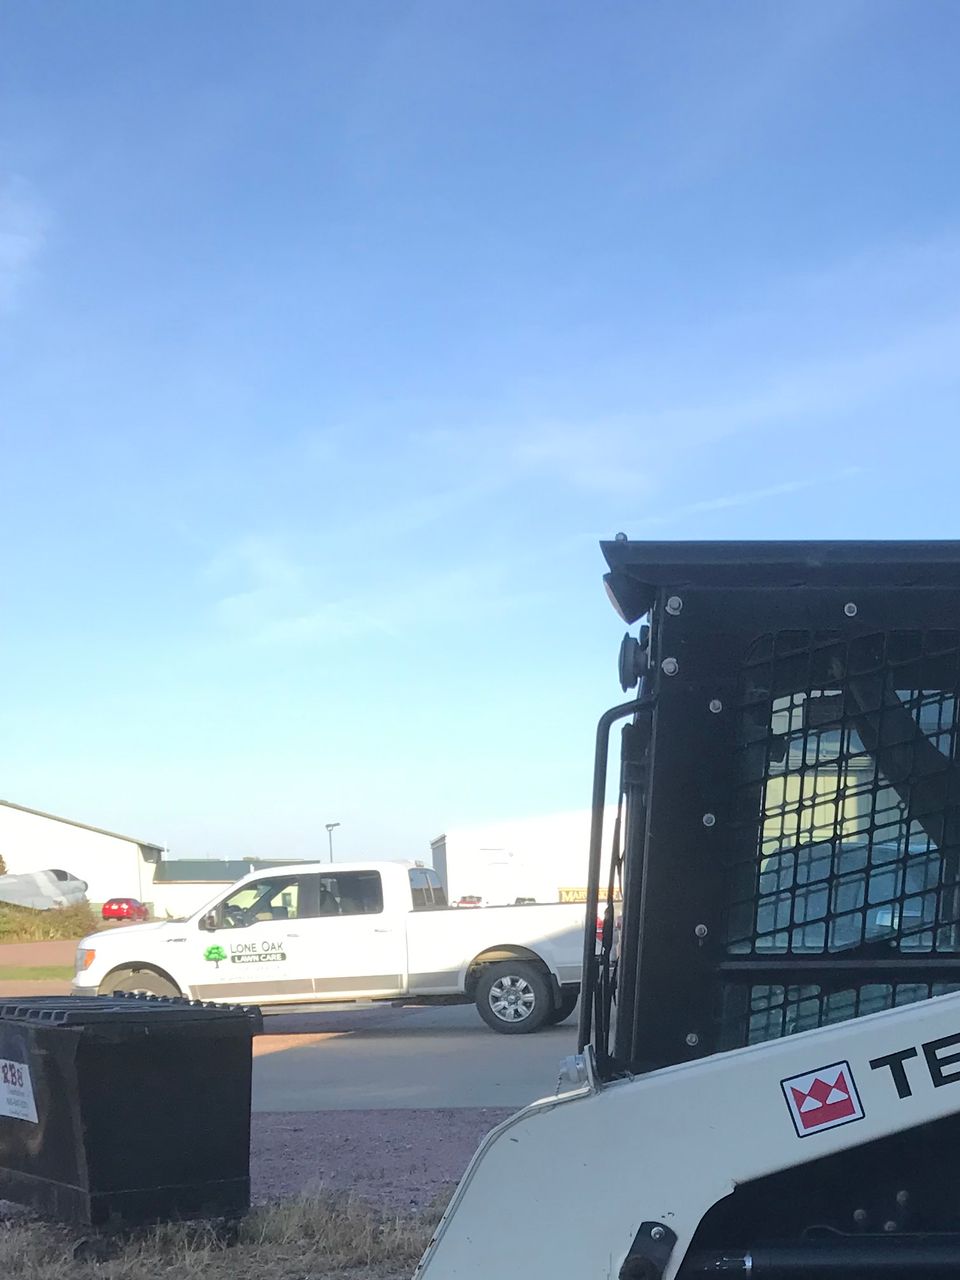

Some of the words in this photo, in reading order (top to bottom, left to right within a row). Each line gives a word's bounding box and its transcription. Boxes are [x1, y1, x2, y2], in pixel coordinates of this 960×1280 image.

[230, 943, 257, 954] LONE
[262, 941, 284, 952] OAK
[234, 955, 260, 963] LAWN
[260, 953, 282, 961] CARE
